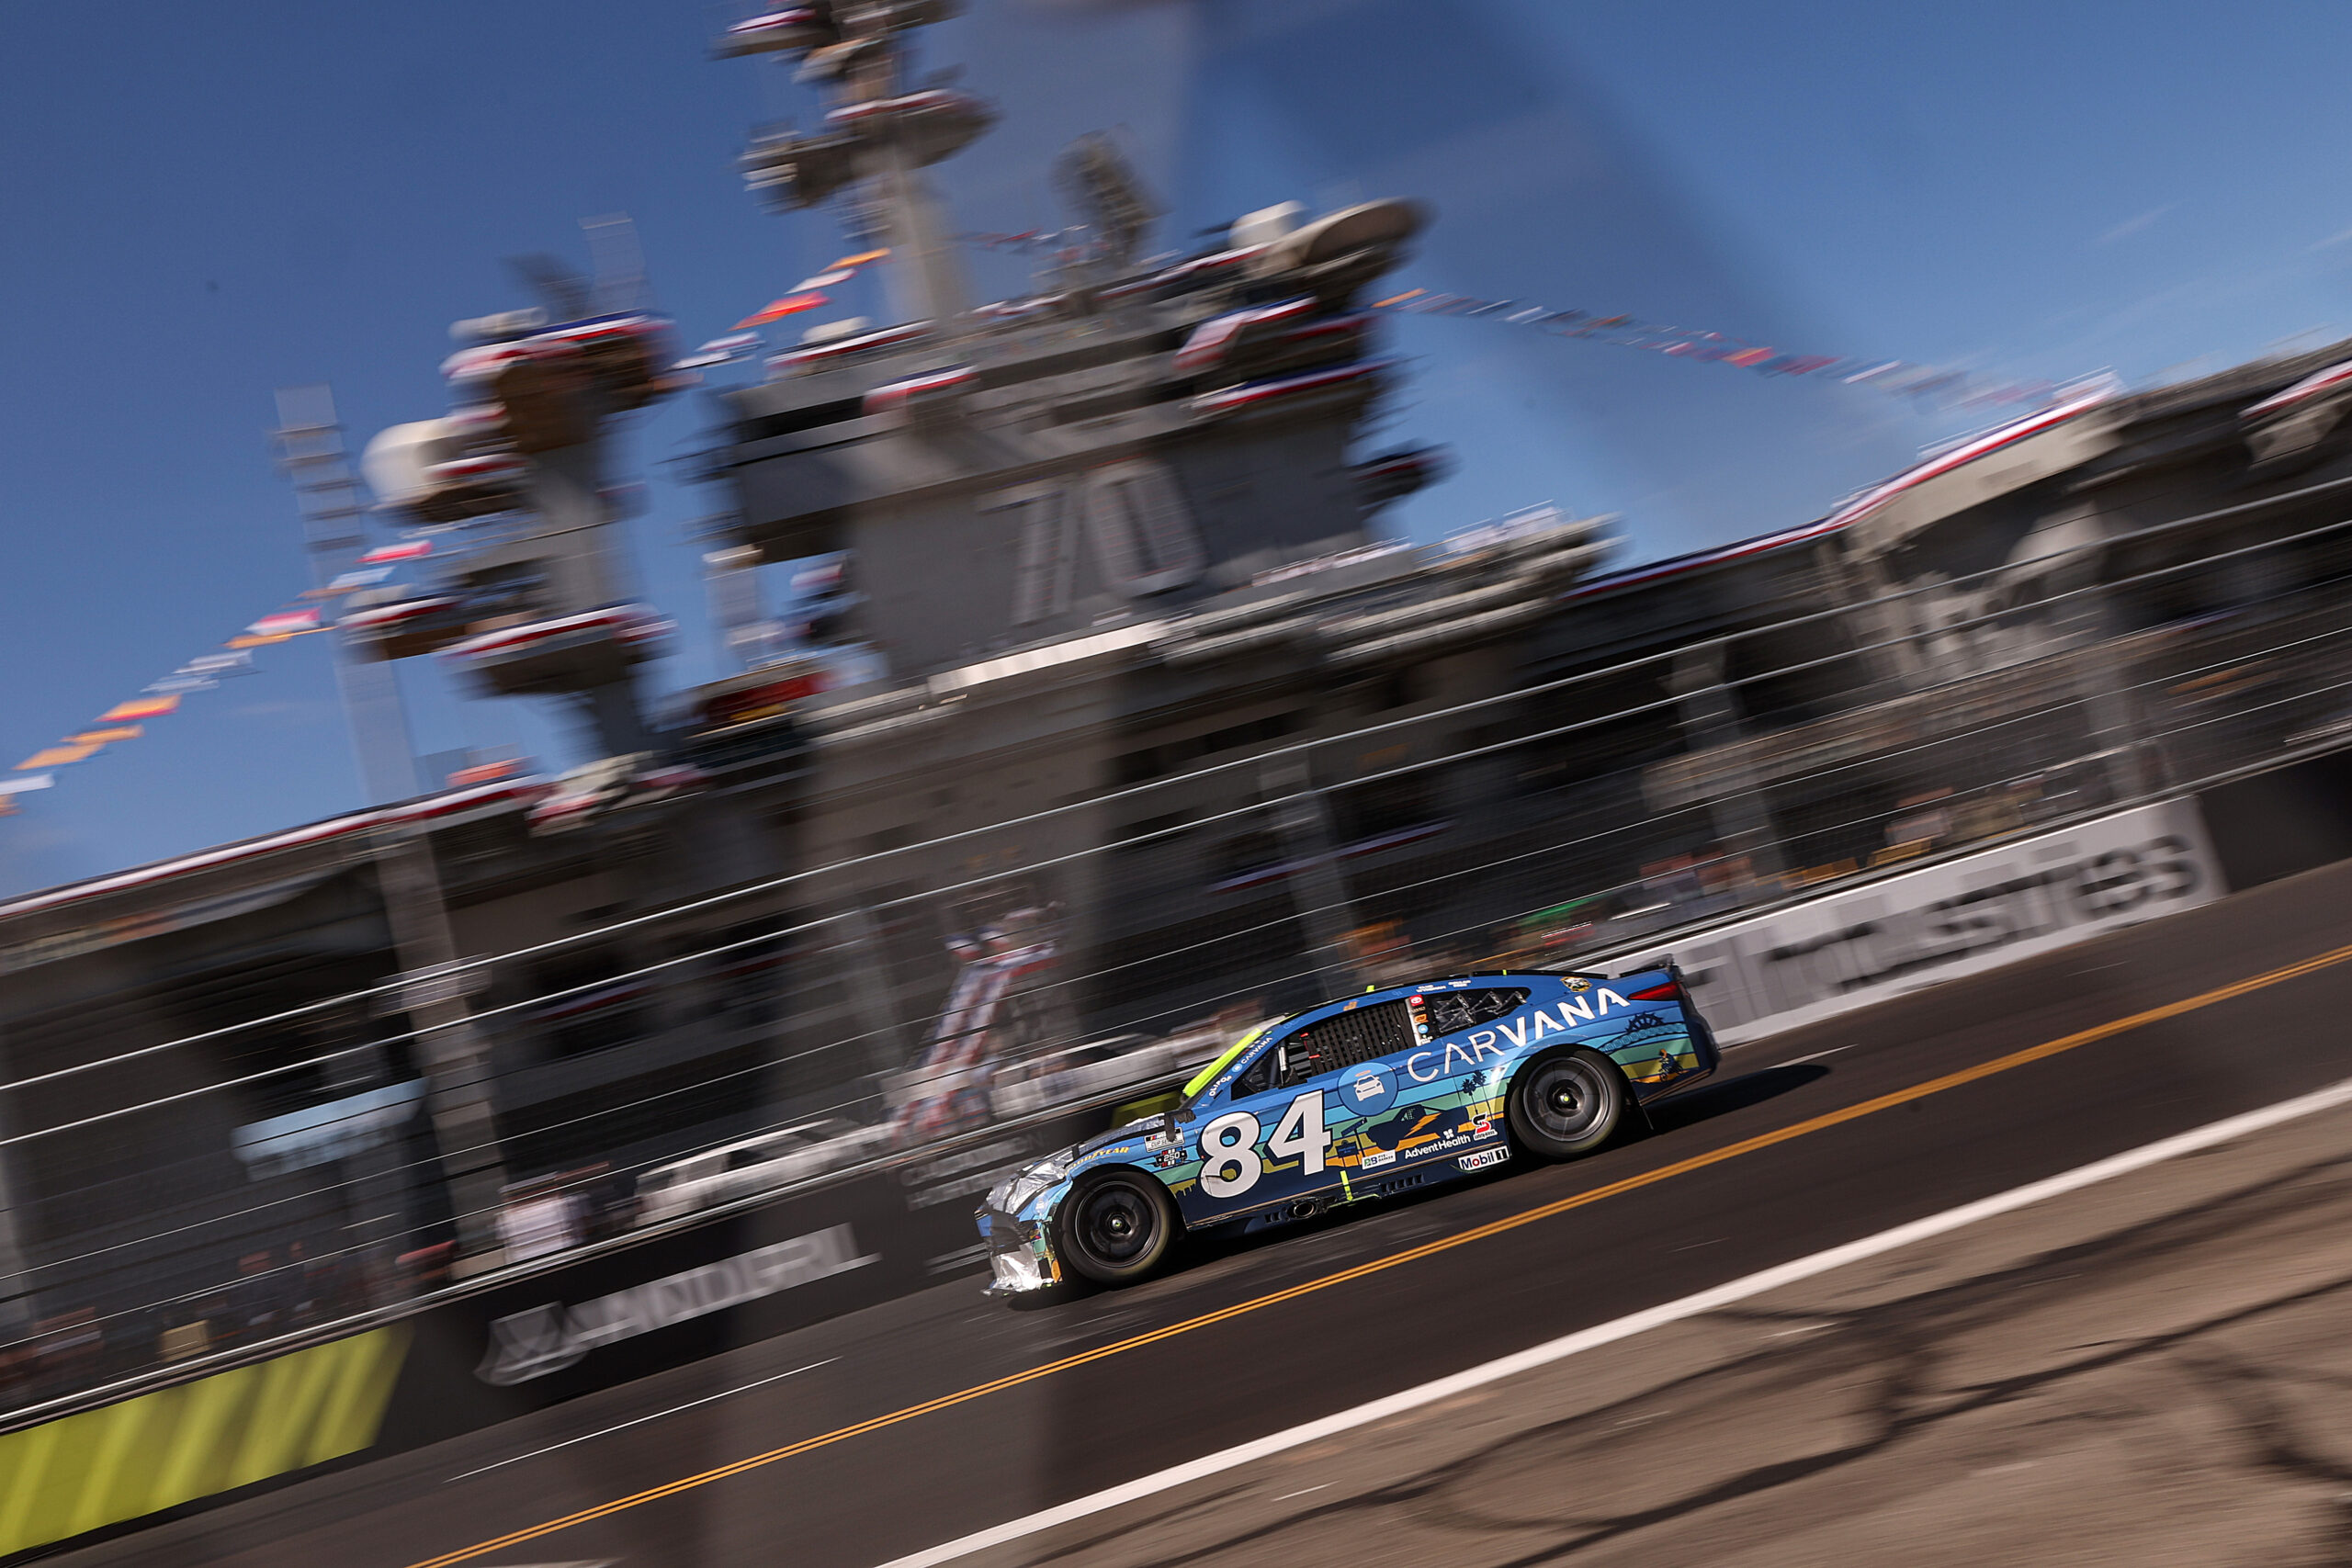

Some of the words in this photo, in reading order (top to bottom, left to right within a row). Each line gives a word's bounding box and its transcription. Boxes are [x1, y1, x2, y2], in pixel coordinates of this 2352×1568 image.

[1408, 987, 1630, 1082] CARVANA
[1241, 1037, 1273, 1064] CARVANA
[1208, 1075, 1232, 1097] OLIPOP
[1200, 1089, 1331, 1198] 84
[1405, 1134, 1471, 1159] AdventHealth
[1164, 1152, 1180, 1162] 250
[1461, 1154, 1494, 1169] Mobil
